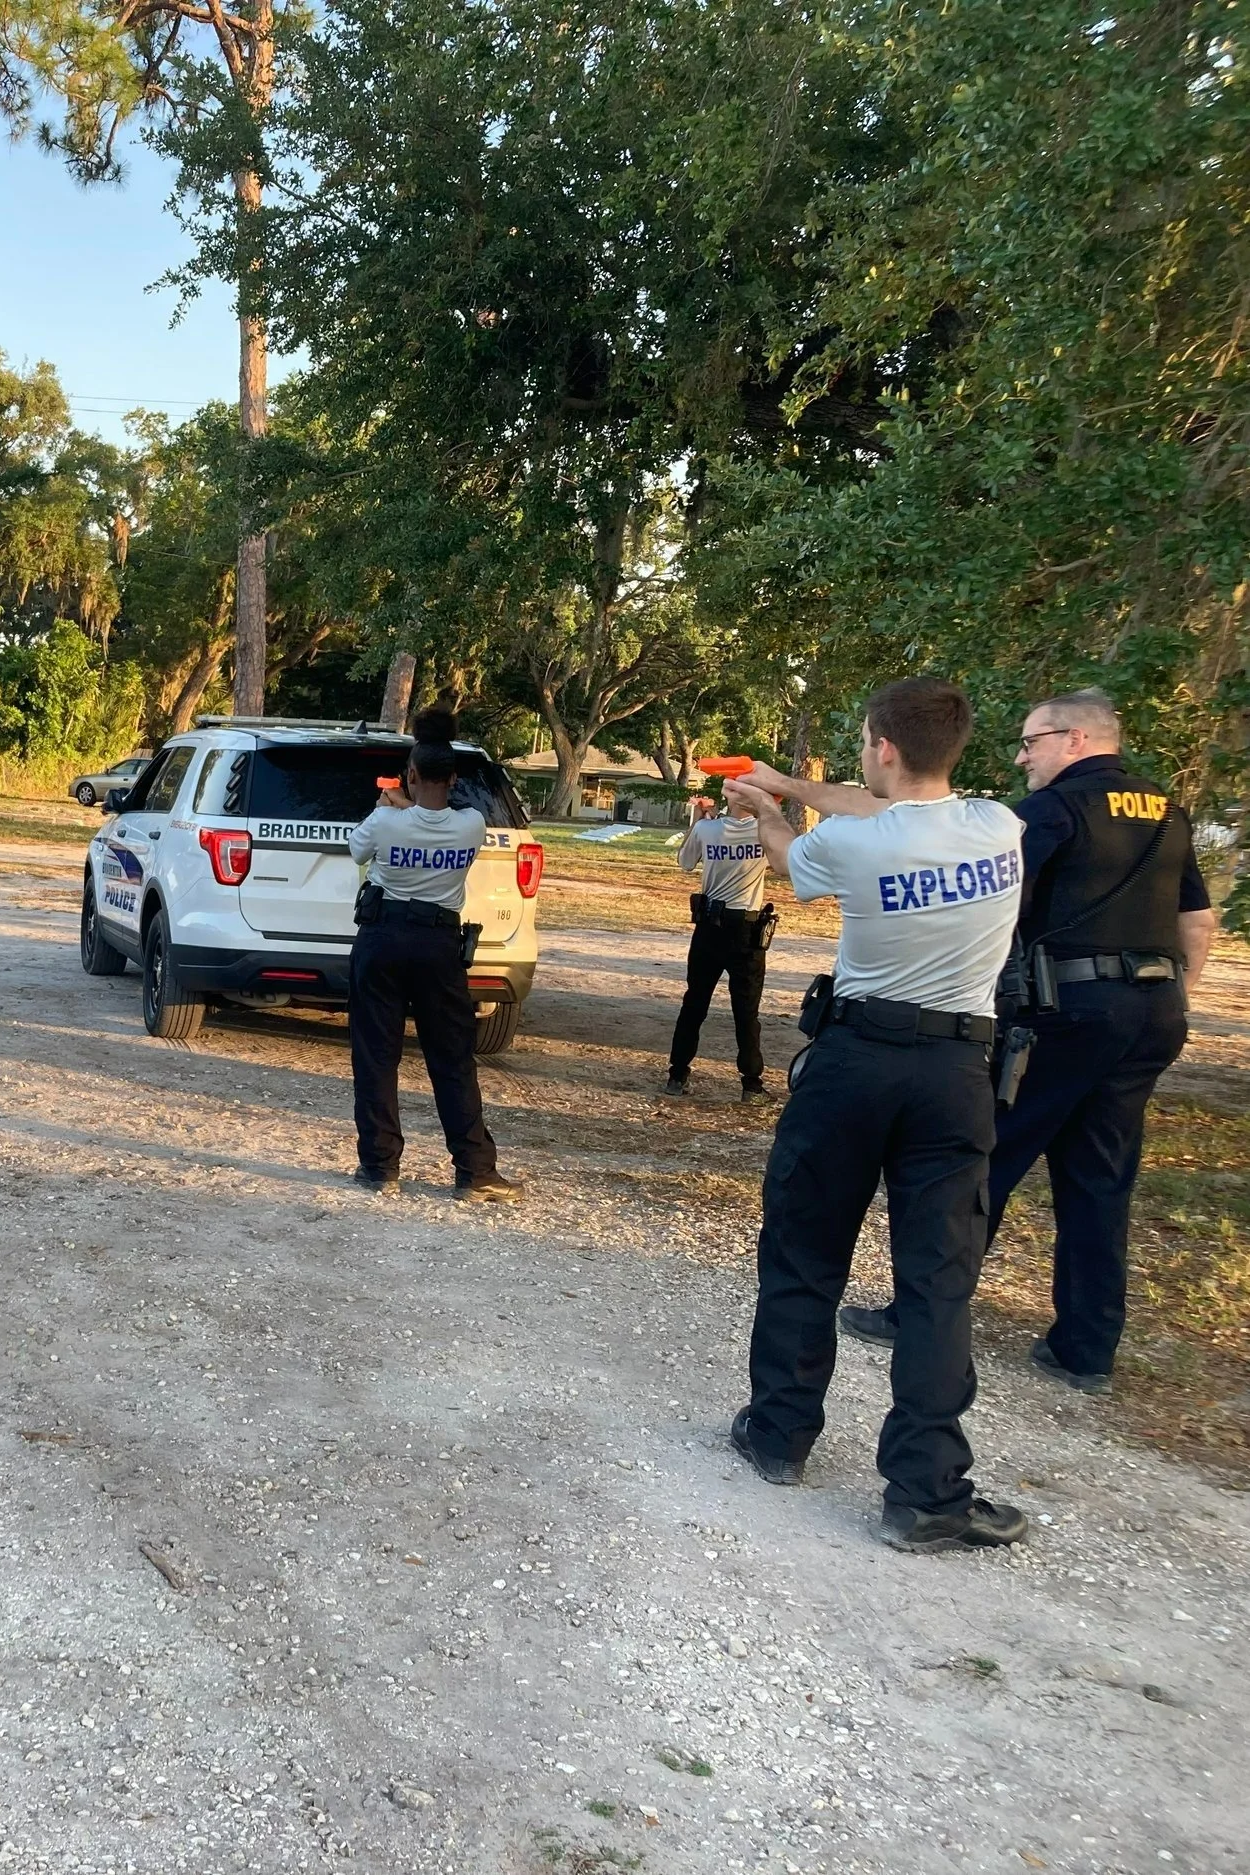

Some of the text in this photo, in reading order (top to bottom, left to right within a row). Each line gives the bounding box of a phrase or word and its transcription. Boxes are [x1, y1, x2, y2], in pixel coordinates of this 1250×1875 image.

[258, 823, 354, 841] BRADENTO
[390, 846, 475, 870] EXPLORER
[706, 843, 766, 861] EXPLORE
[878, 848, 1021, 912] EXPLORER
[104, 884, 137, 913] POLICE
[497, 909, 511, 921] 180
